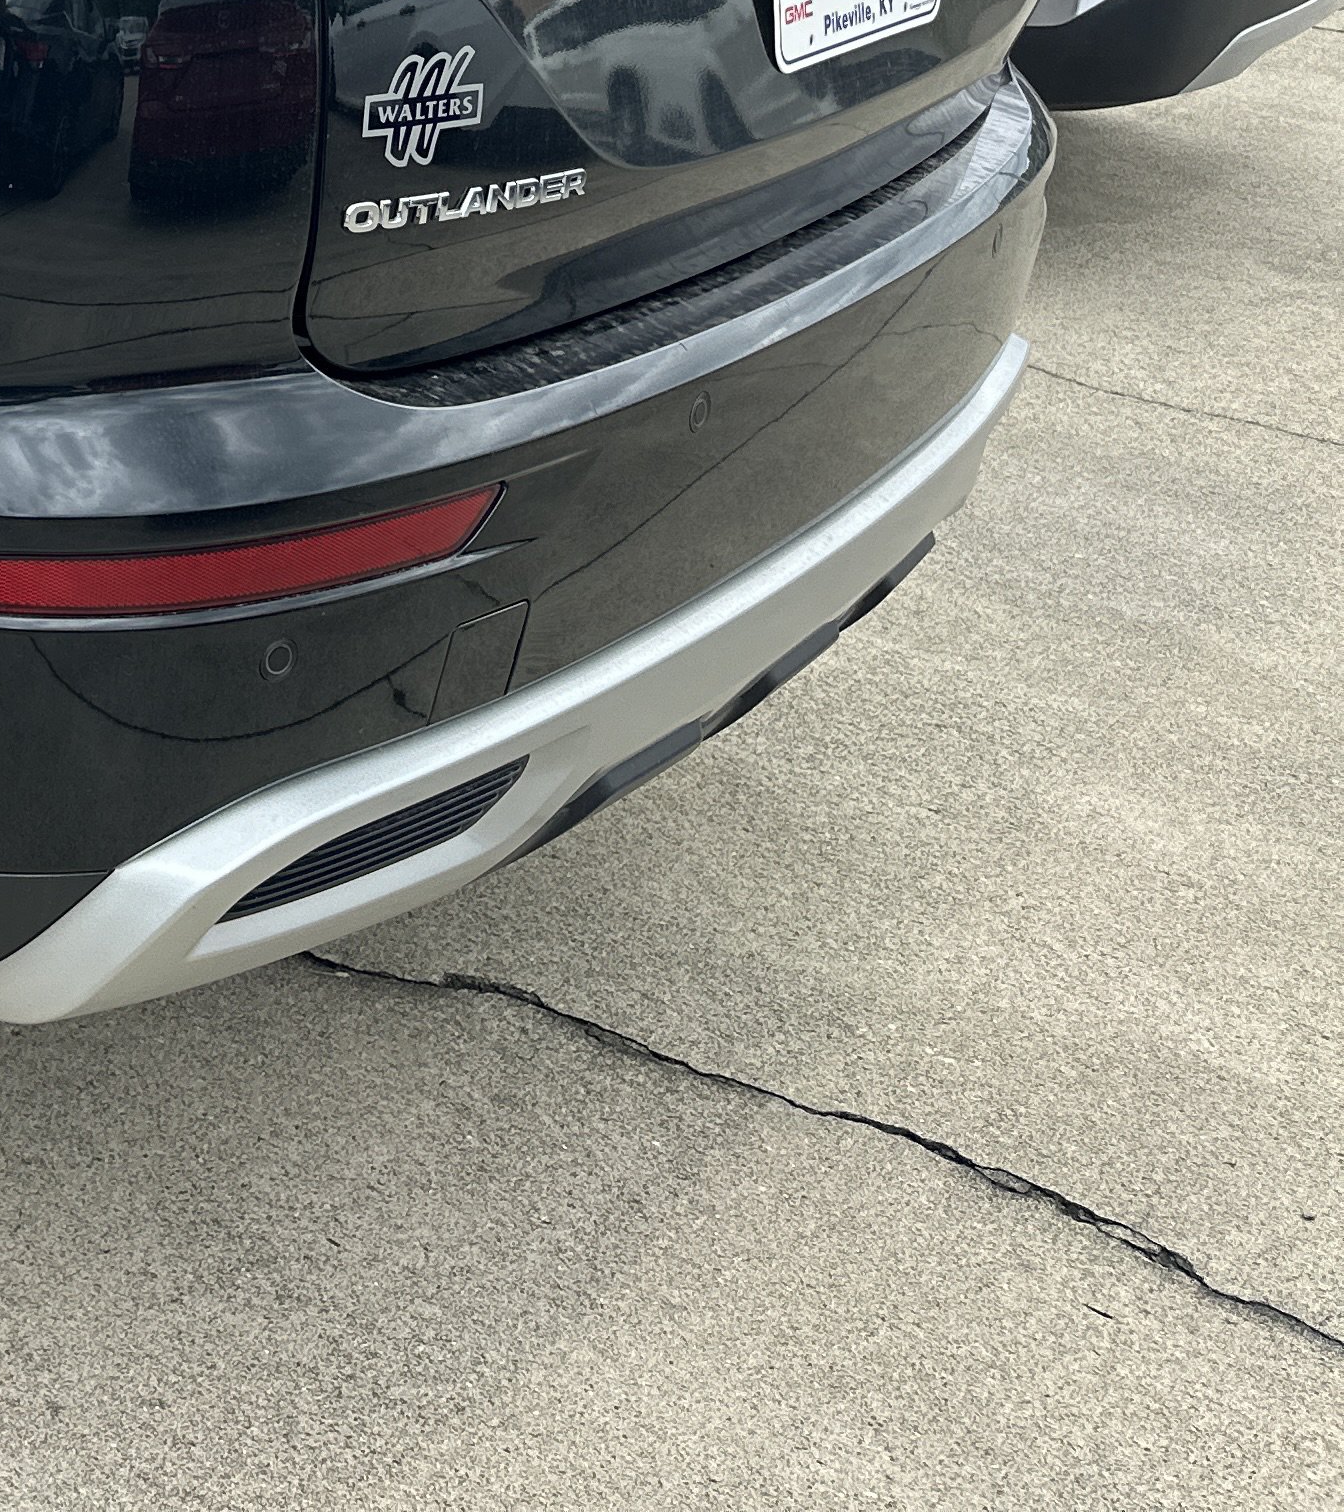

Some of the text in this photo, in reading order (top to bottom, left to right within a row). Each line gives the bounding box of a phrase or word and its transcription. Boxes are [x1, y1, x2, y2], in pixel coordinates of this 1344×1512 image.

[784, 0, 813, 25] GMC
[824, 0, 876, 36] Pikeville,
[377, 95, 473, 124] WALTERS
[343, 168, 587, 233] OUTLANDER
